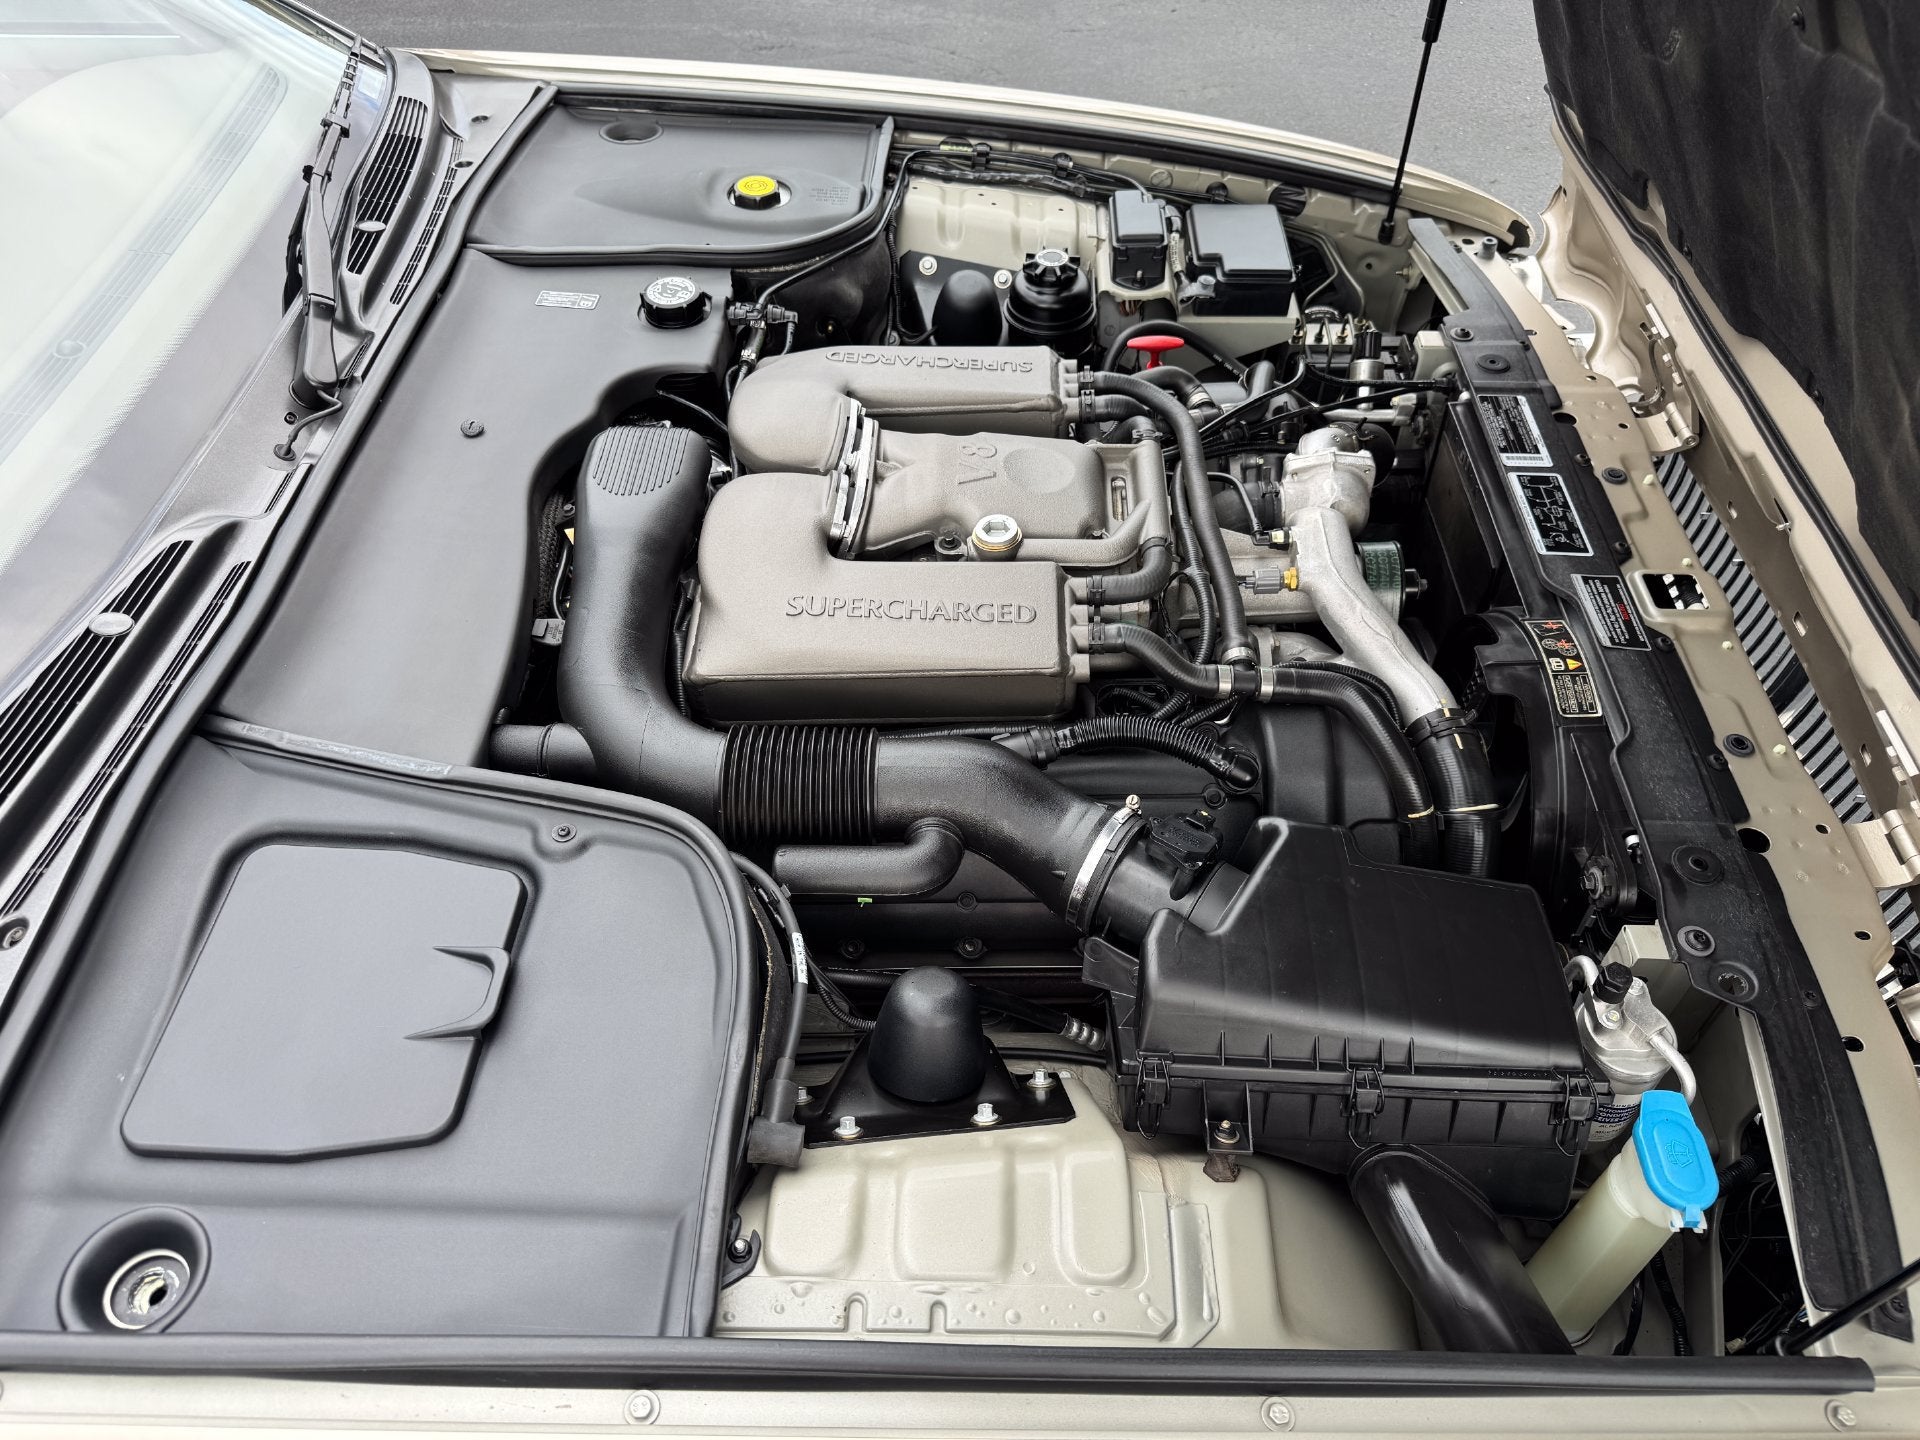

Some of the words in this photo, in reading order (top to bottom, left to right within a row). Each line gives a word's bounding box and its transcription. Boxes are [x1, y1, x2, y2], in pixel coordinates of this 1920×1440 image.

[825, 351, 1033, 373] SUPERCHARGED
[957, 442, 998, 485] V8
[785, 594, 1037, 624] SUPERCHARGED
